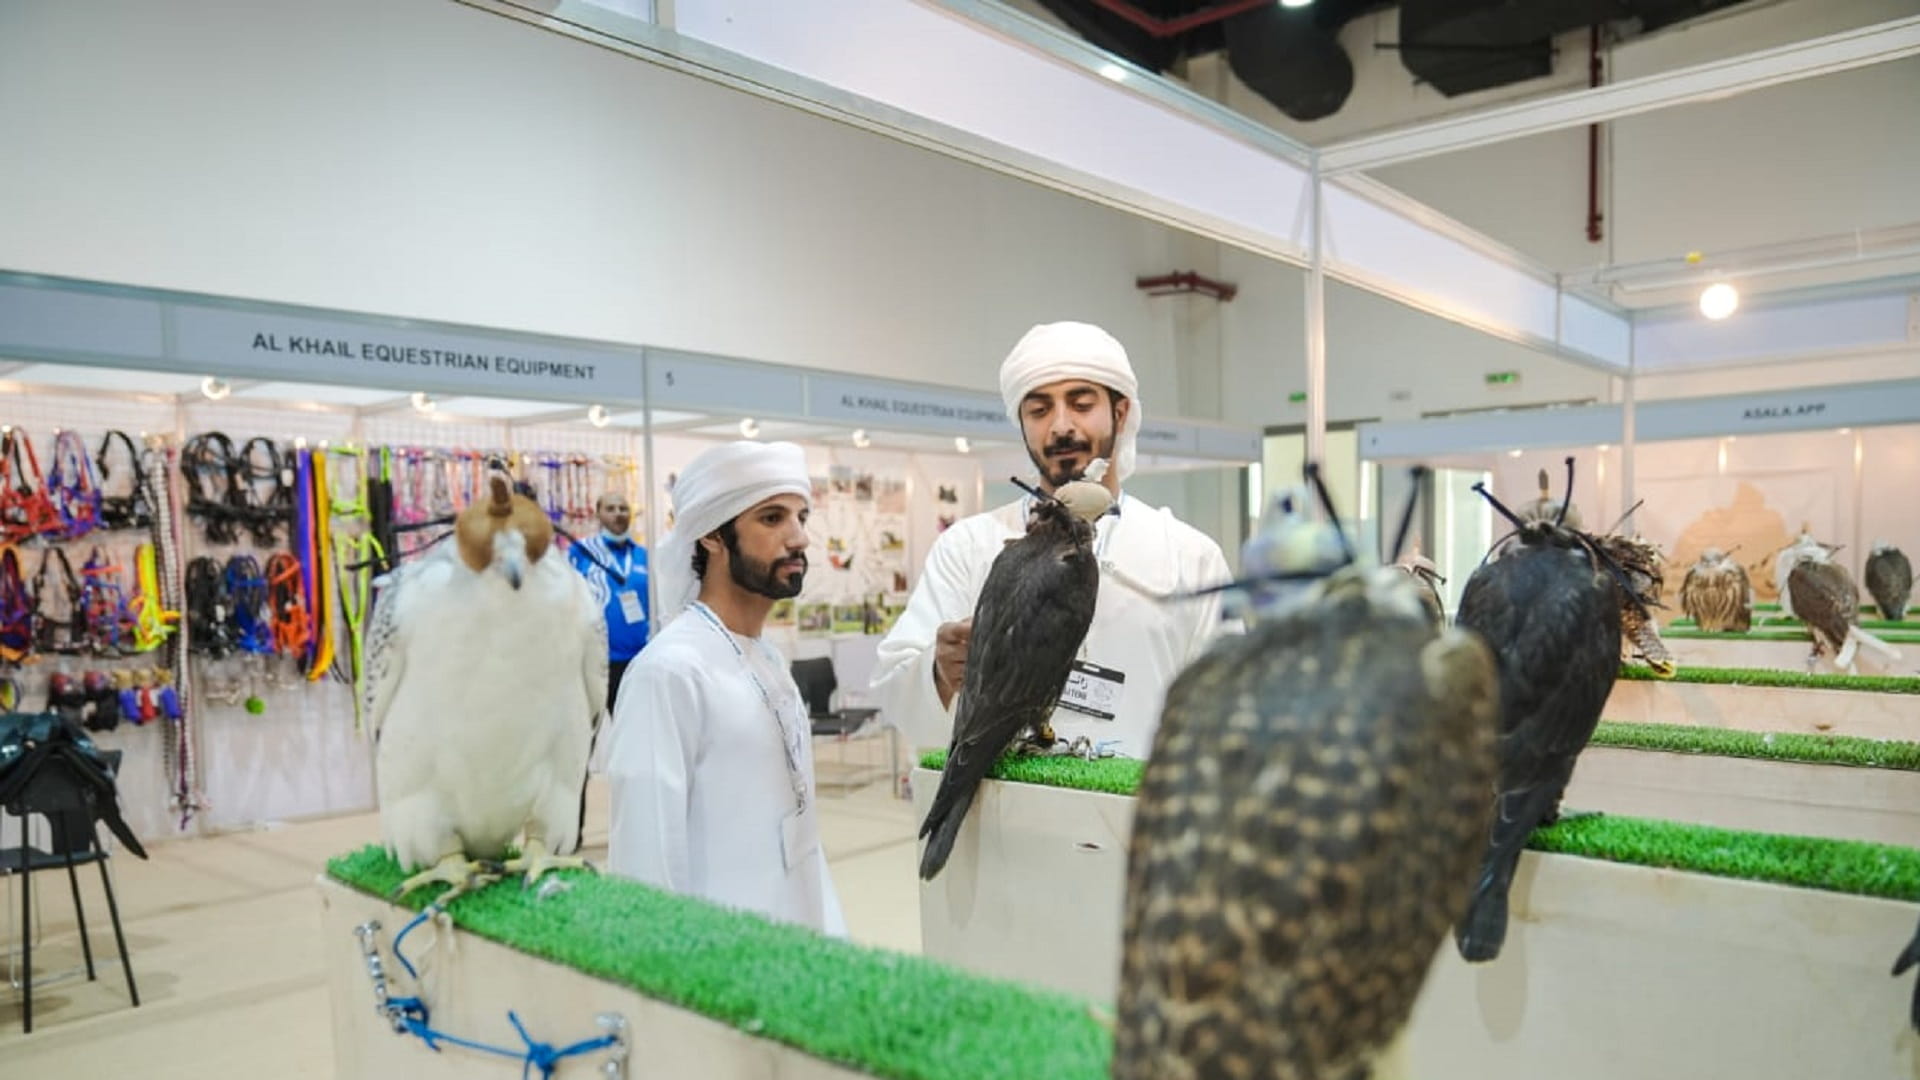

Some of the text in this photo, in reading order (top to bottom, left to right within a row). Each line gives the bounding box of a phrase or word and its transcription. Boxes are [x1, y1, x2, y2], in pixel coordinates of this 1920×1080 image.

[252, 333, 596, 381] AL KHAIL EQUESTRIAN EQUIPMENT
